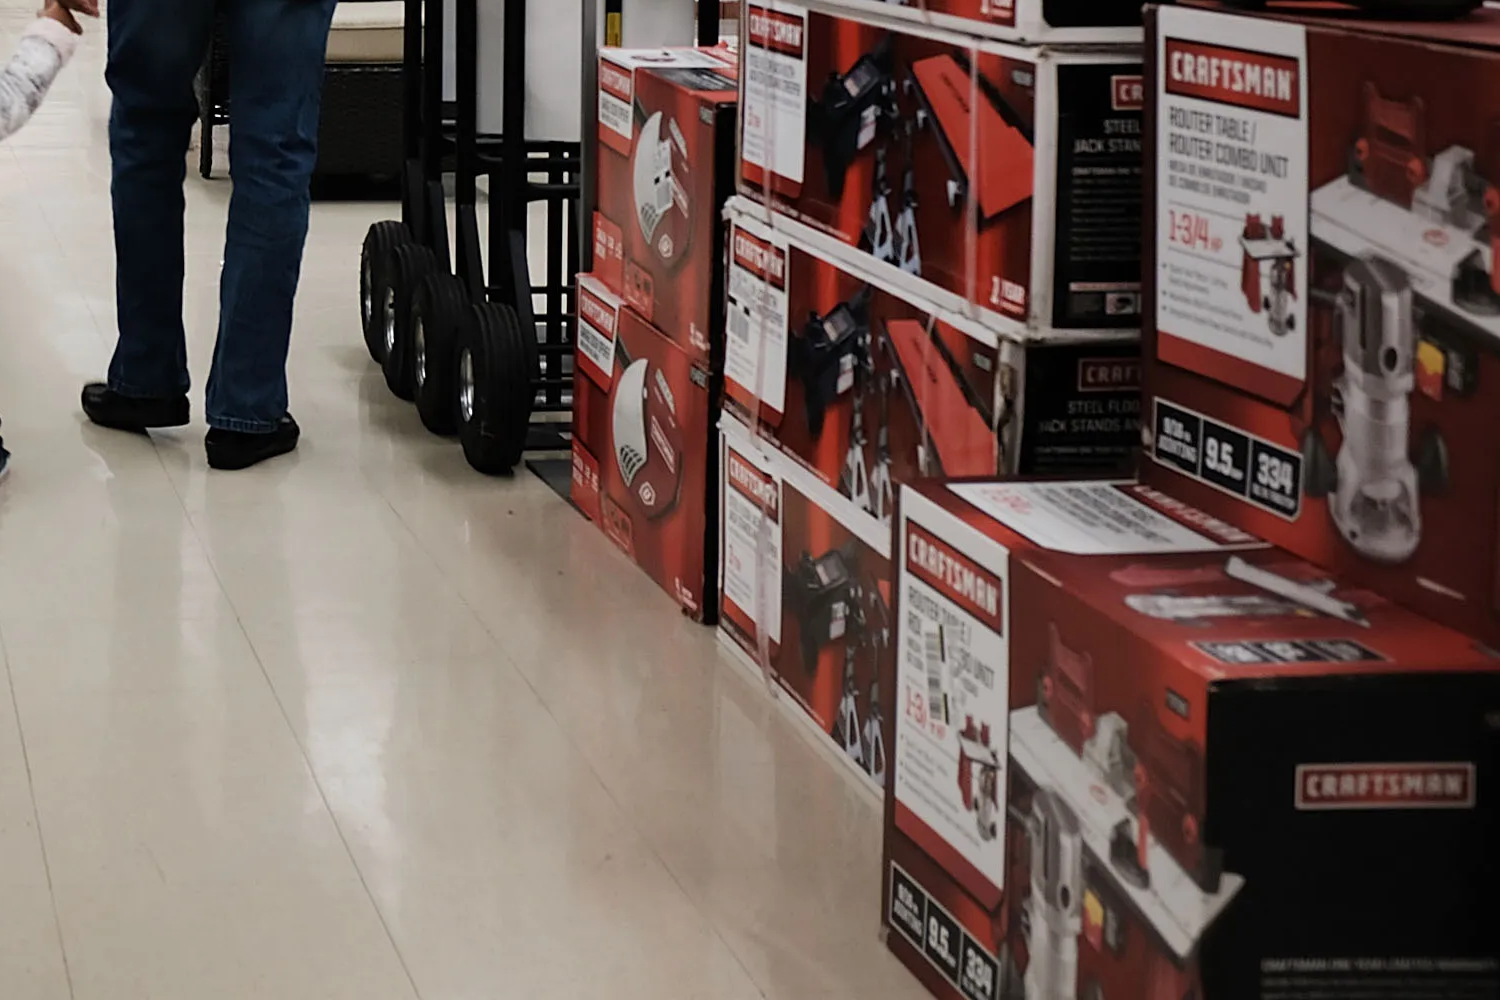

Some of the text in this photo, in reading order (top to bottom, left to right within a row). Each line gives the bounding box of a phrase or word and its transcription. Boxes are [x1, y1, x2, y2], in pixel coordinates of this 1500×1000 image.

[1170, 50, 1294, 103] CRAFTSMAN
[1170, 106, 1213, 134] ROUTER
[1215, 115, 1250, 143] TABLE
[1109, 139, 1141, 153] STAN
[1170, 133, 1289, 179] ROUTER COMBO UNIT
[909, 532, 998, 617] CRAFTSMAN
[1306, 773, 1464, 798] CRAFTSMAN
